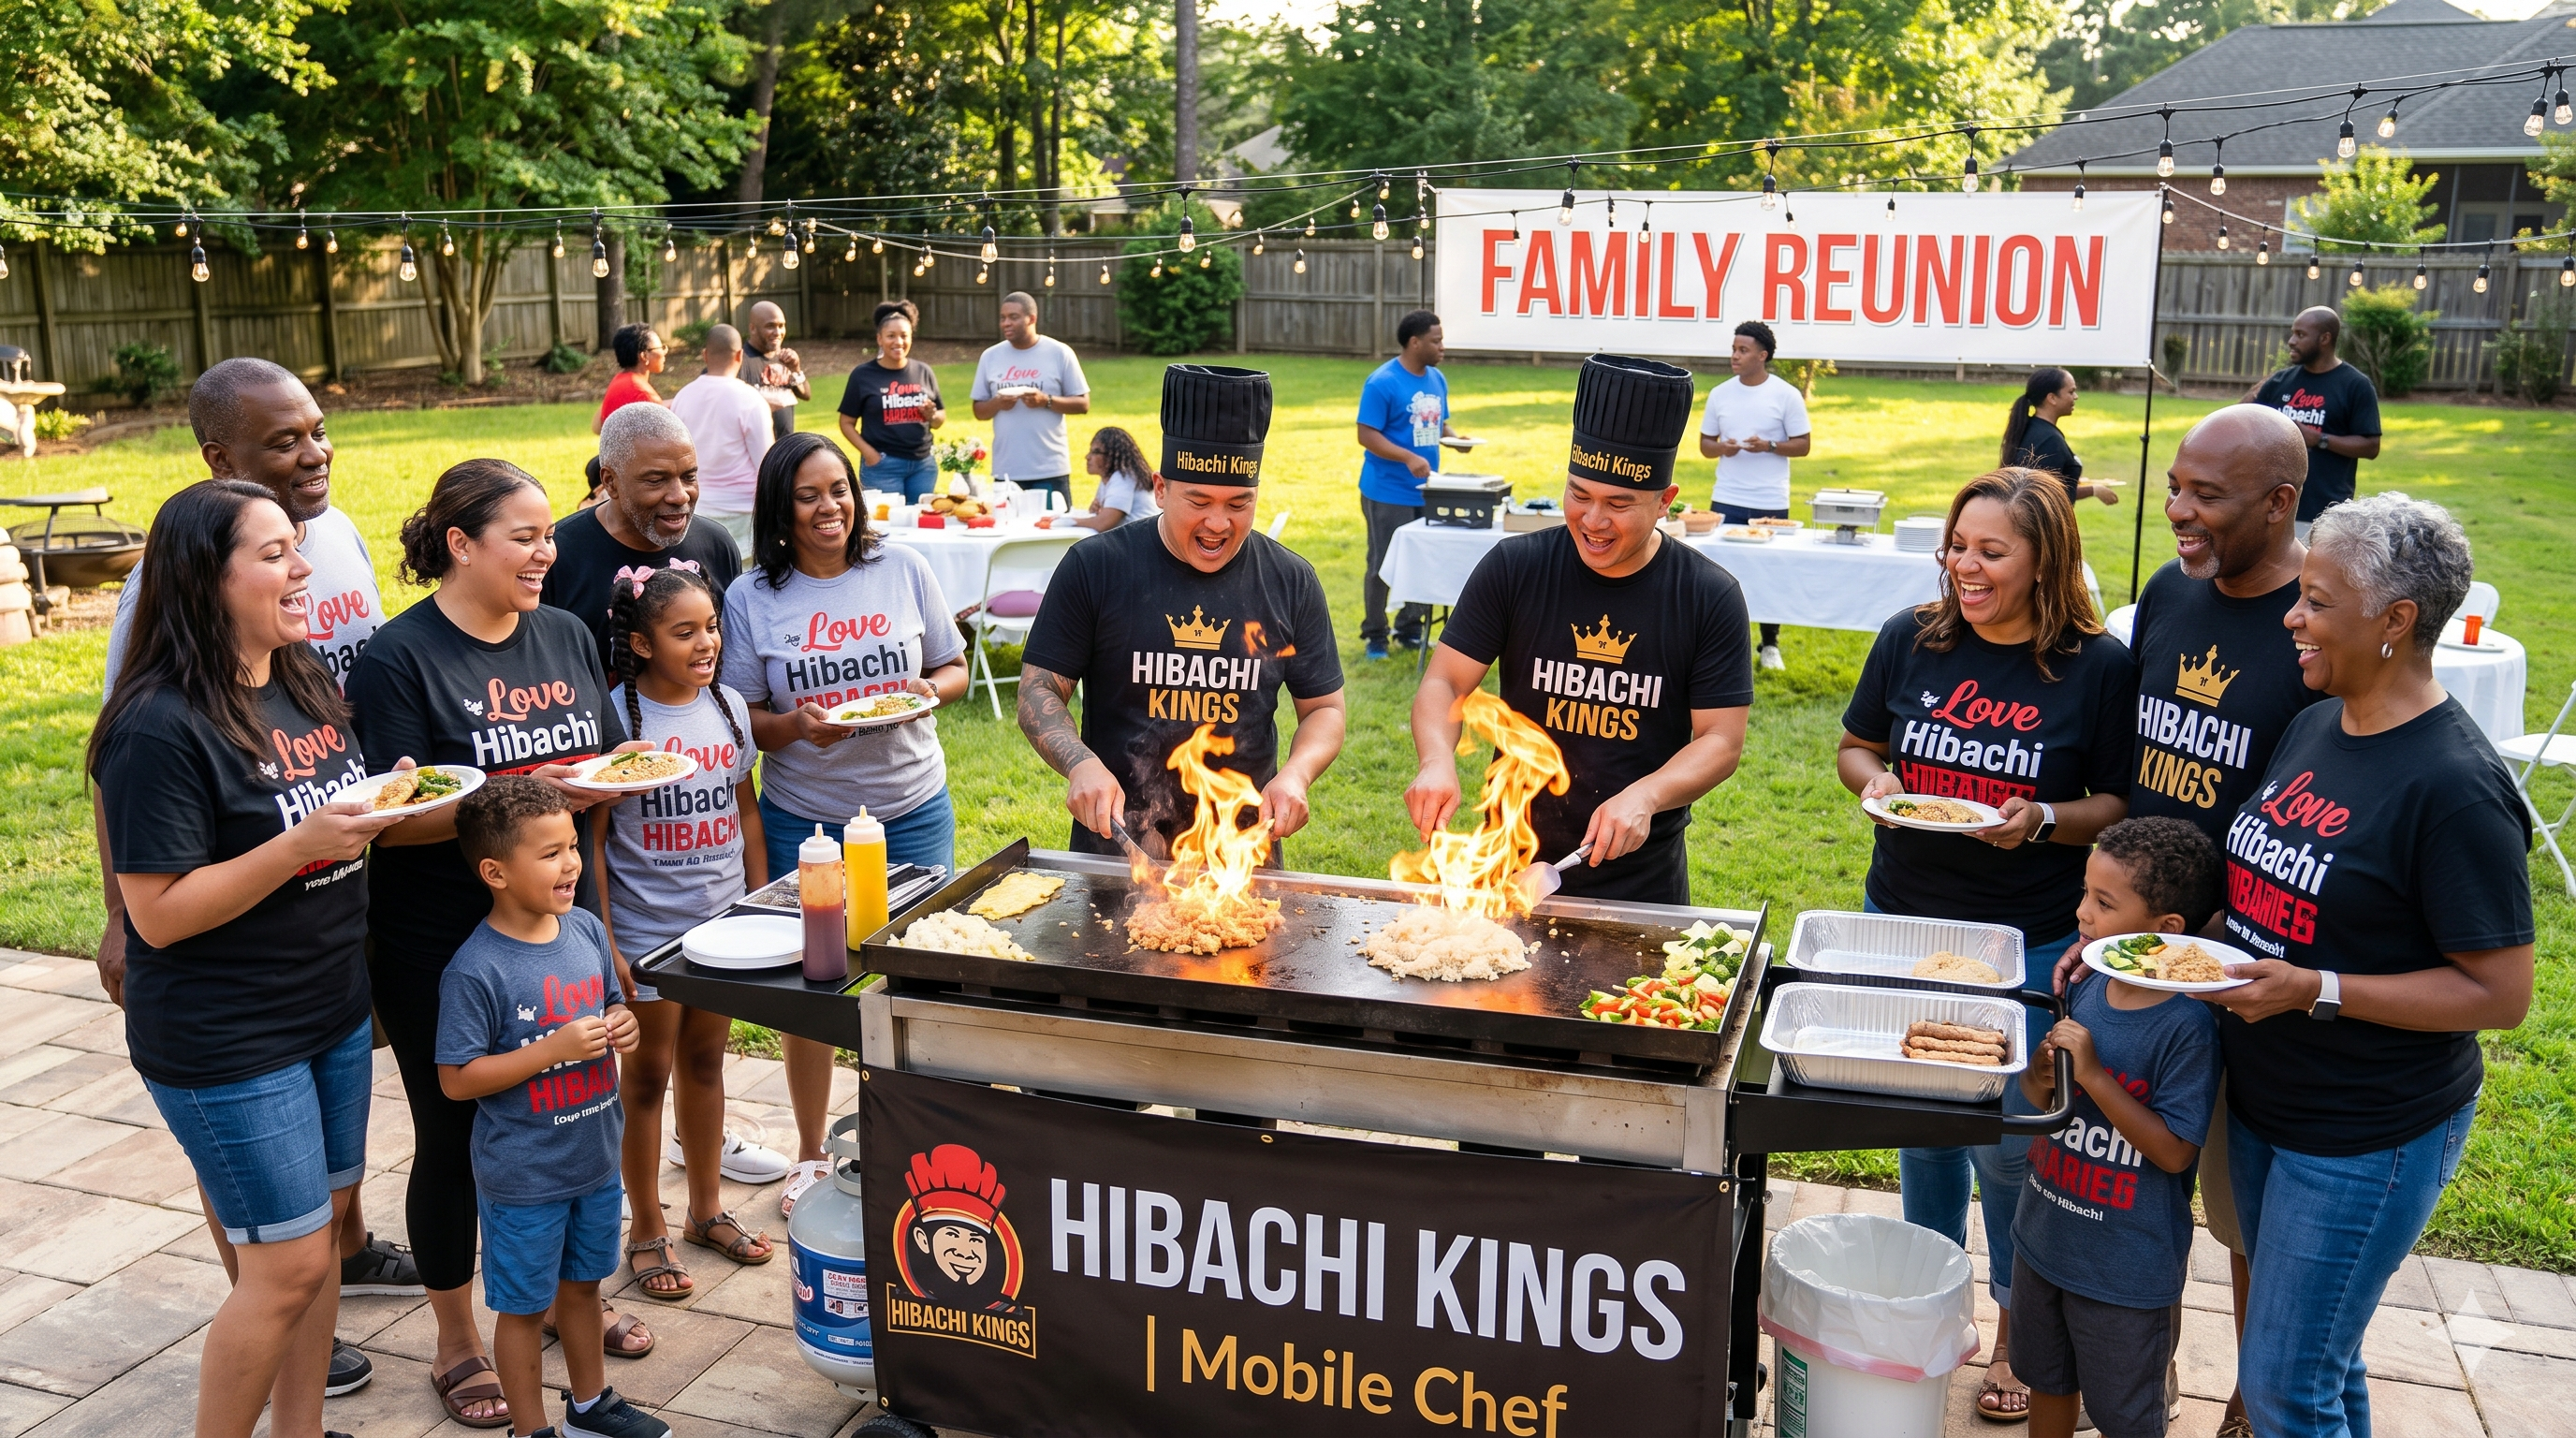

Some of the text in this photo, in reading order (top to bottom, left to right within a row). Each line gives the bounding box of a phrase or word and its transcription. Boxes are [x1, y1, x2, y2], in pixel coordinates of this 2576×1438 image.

[1481, 229, 2107, 330] FAMILY REUNION
[1002, 365, 1041, 381] Love
[2287, 388, 2325, 408] Love
[1177, 450, 1258, 478] Hibachi Kings
[1611, 455, 1652, 482] Kings
[800, 611, 891, 653] Love
[785, 641, 909, 692] Hibachi
[1132, 651, 1261, 691] HIBACHI
[1531, 657, 1662, 709] HIBACHI
[486, 678, 576, 722] Love
[1149, 688, 1240, 724] KINGS
[1545, 697, 1640, 741] KINGS
[1931, 679, 2042, 732] Love
[271, 724, 346, 782] Love
[471, 710, 599, 767] Hibachi
[1900, 719, 2043, 779] Hibachi
[2137, 694, 2251, 770] HIBACHI
[2138, 745, 2222, 809] KINGS
[2261, 770, 2350, 838] Love
[642, 811, 739, 852] HIBACHI
[2226, 811, 2334, 896] Hibachi
[1050, 1178, 1686, 1360] HIBACHI KINGS
[891, 1299, 1031, 1349] HIBACHI KINGS
[1181, 1328, 1393, 1415] Mobile
[1413, 1366, 1568, 1438] Chef
